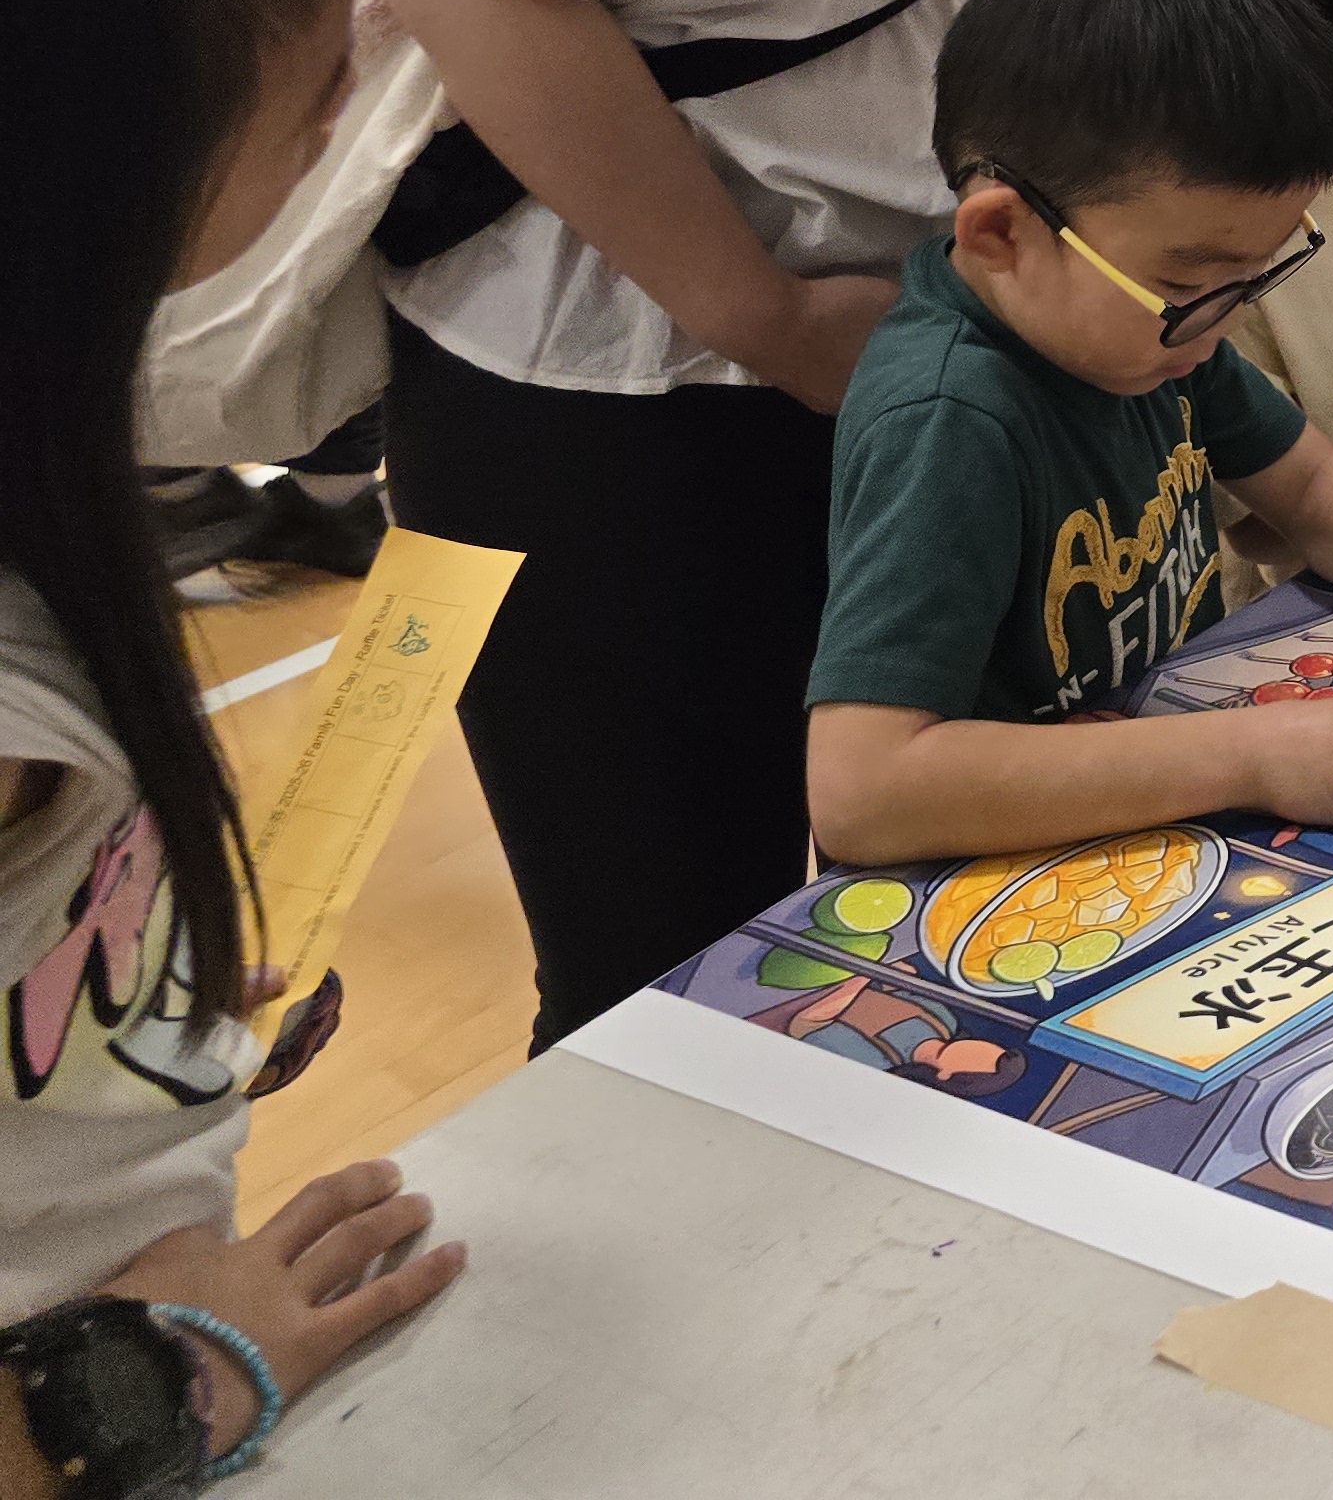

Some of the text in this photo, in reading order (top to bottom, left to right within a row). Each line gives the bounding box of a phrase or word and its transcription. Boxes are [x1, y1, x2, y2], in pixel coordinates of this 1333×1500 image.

[306, 719, 336, 758] Family
[327, 693, 346, 718] Fun
[339, 670, 361, 695] Day
[355, 626, 380, 662] Raffle
[372, 593, 398, 624] Ticket
